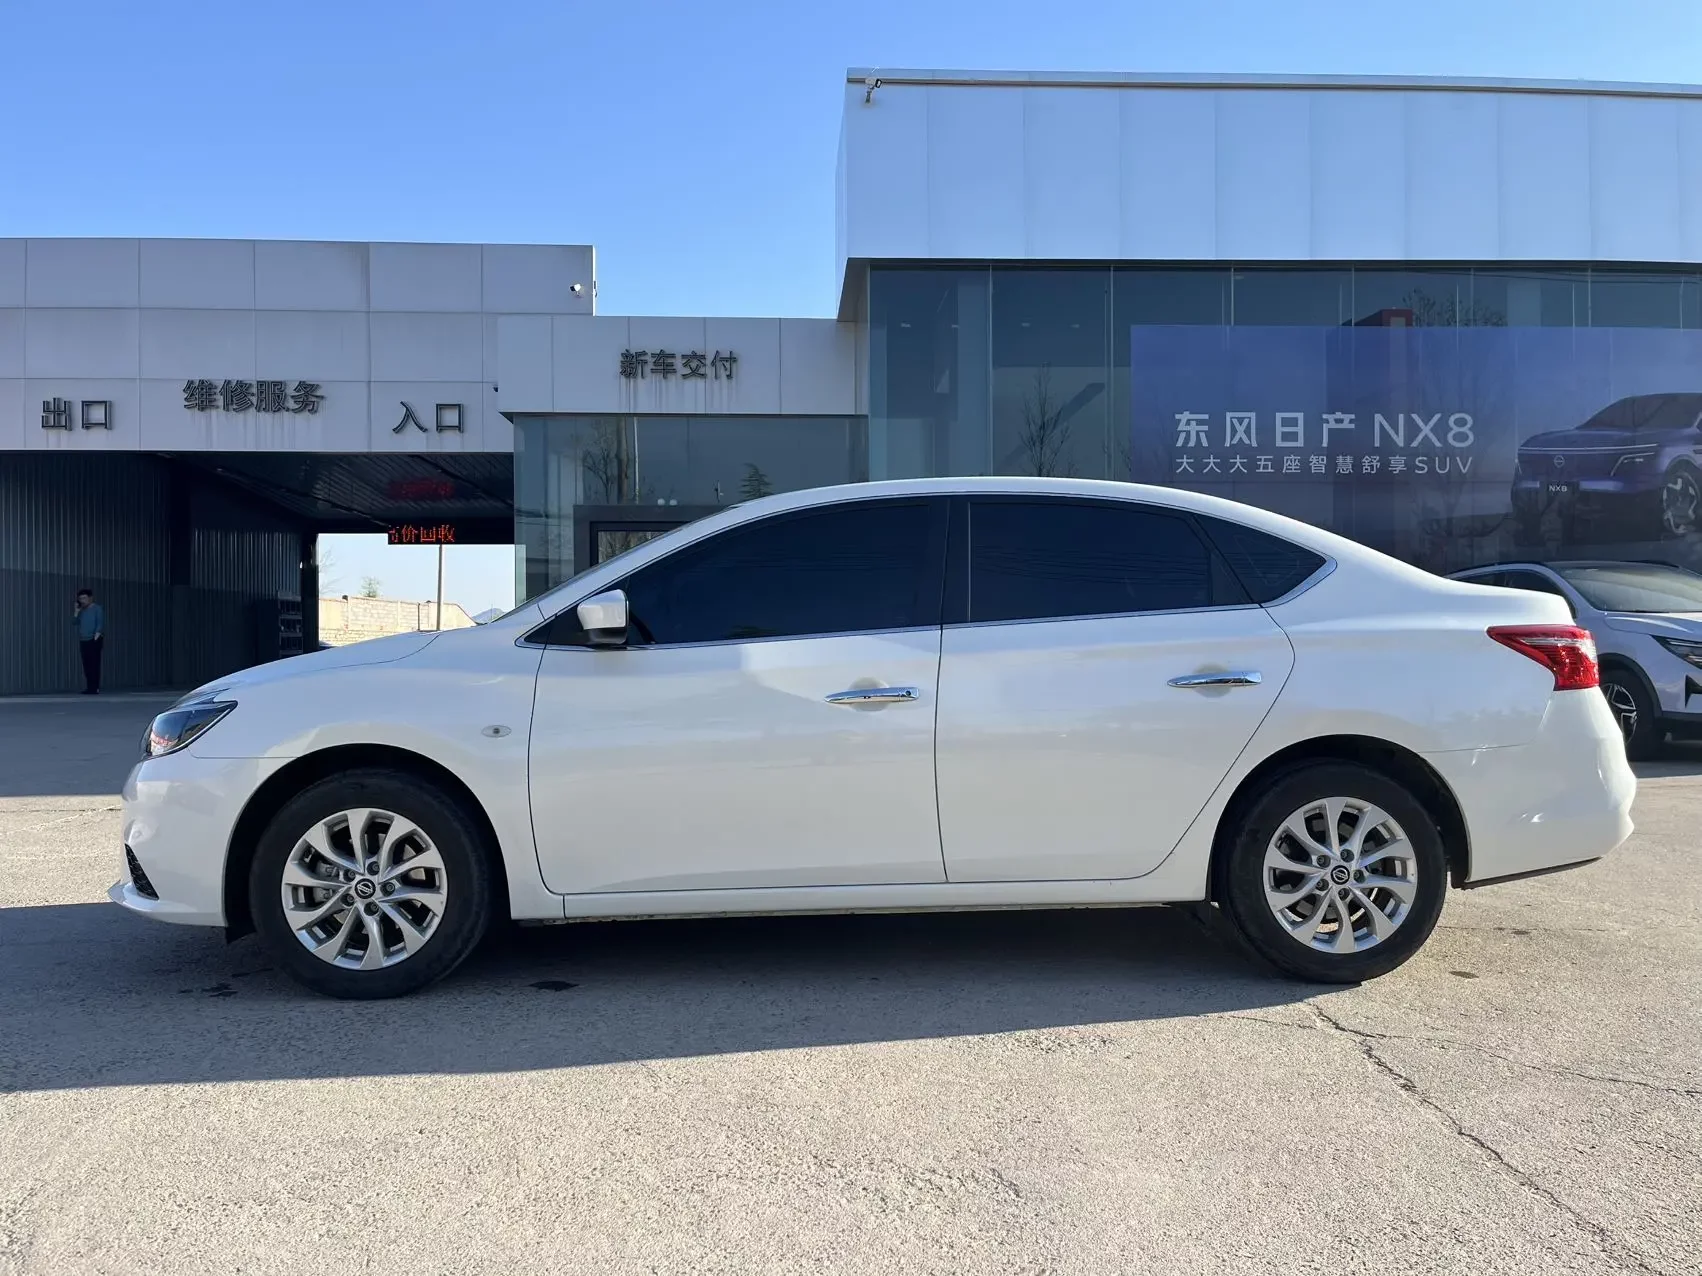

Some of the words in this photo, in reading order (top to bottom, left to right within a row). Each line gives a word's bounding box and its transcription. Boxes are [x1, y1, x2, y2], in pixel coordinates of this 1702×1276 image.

[620, 349, 738, 380] 新车交付
[183, 379, 325, 413] 维修服务
[41, 398, 113, 431] 出口
[392, 400, 465, 434] 入口
[1175, 411, 1355, 448] 东风日产
[1373, 412, 1475, 448] NX8
[1175, 454, 1473, 475] 大大大五座智慧舒享SUV
